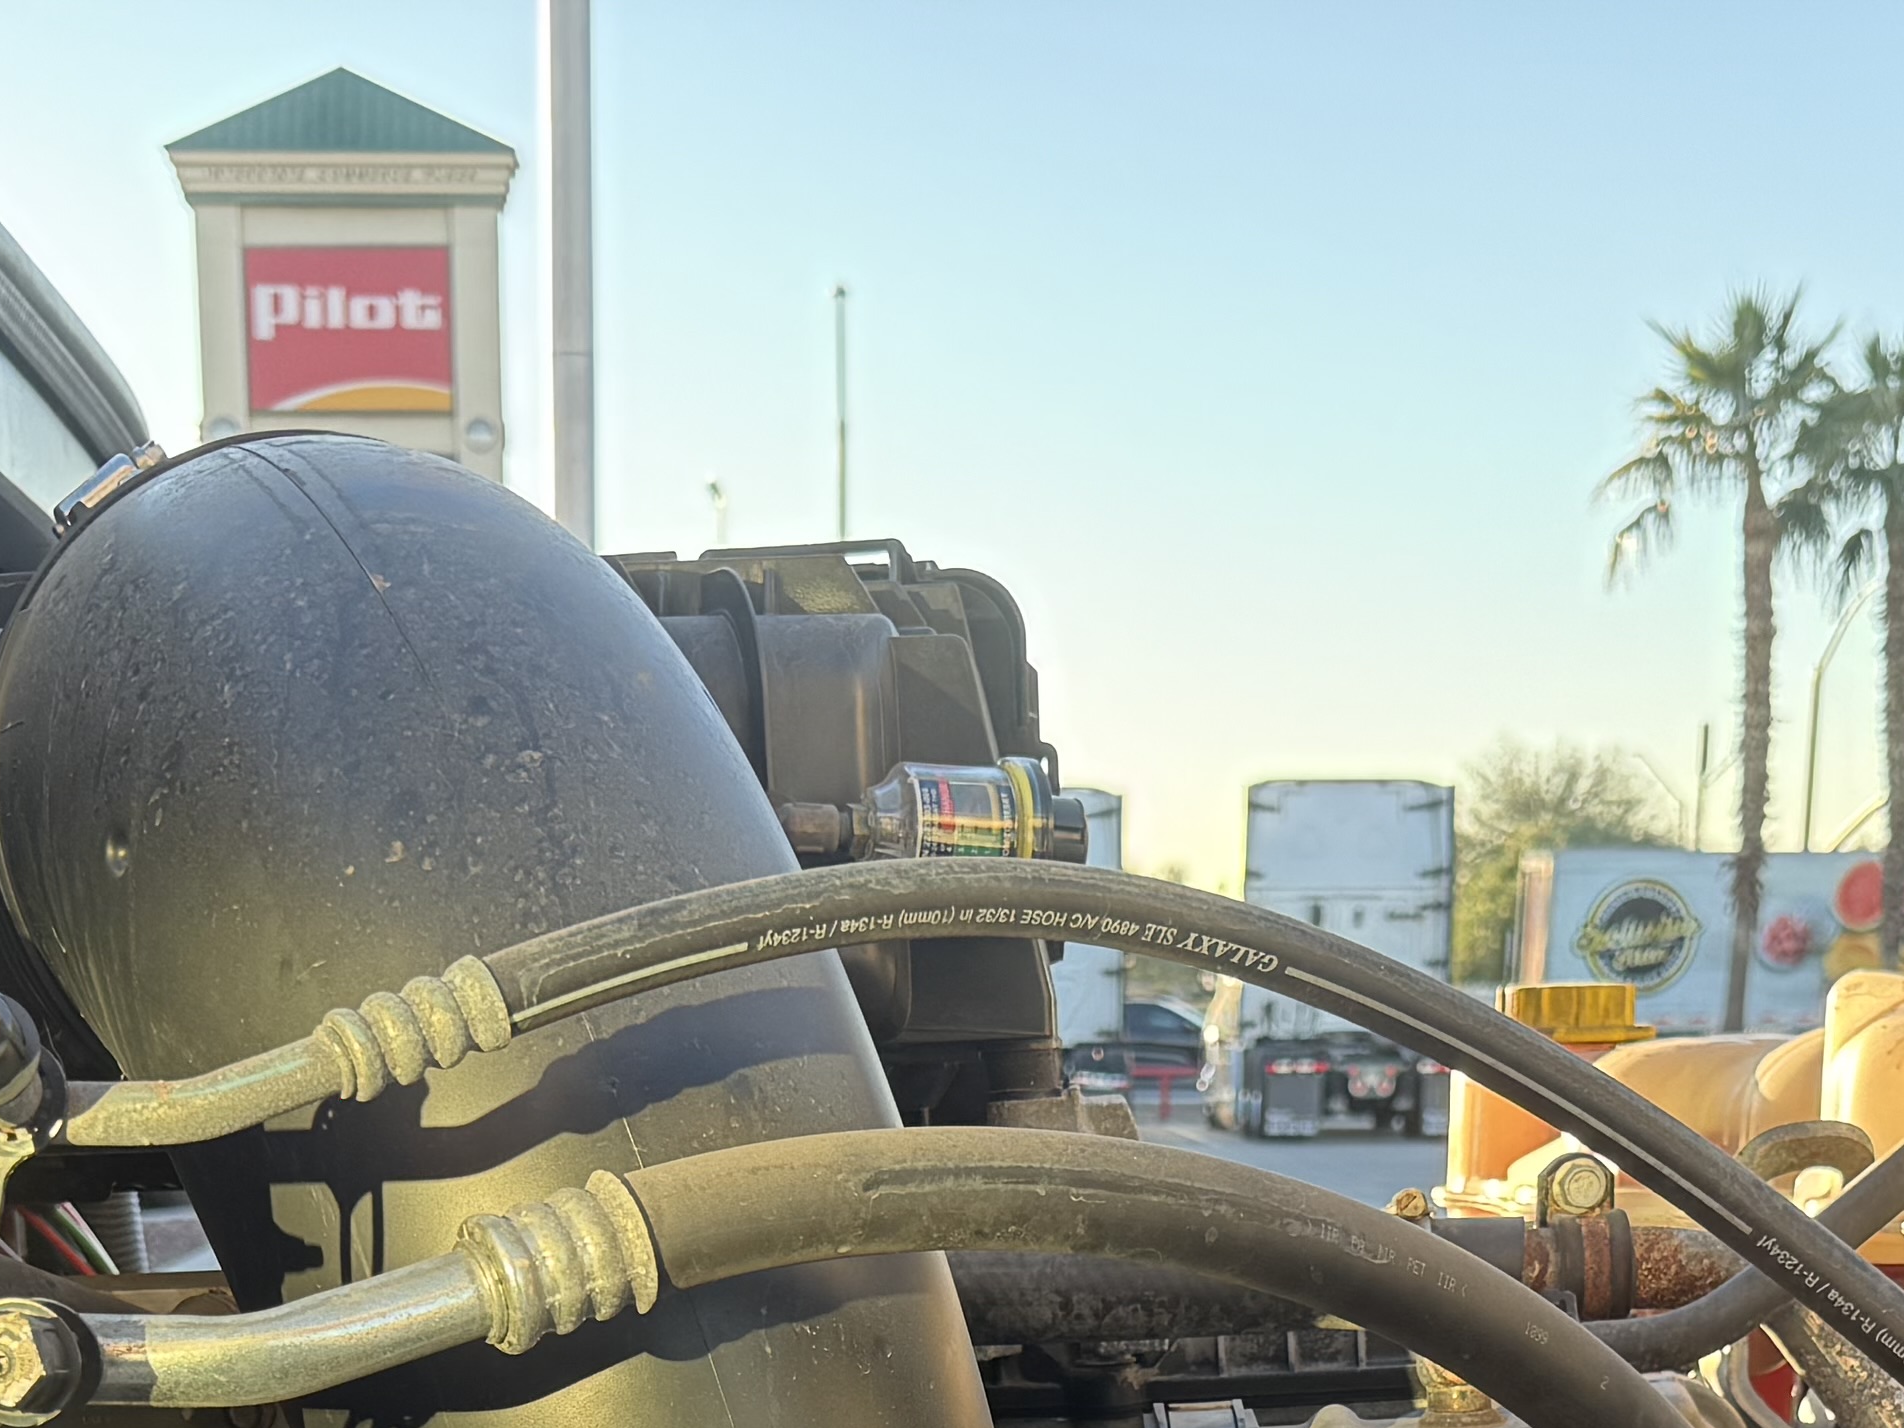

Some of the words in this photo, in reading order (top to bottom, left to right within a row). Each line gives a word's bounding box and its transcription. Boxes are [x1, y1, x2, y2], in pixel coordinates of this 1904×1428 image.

[251, 282, 443, 341] Pilot
[840, 913, 893, 933] R-134a
[898, 906, 956, 928] (10mm)
[959, 908, 973, 922] in
[975, 907, 1016, 924] 13/32
[1020, 909, 1067, 927] HOSE
[1069, 912, 1100, 930] A/C
[756, 924, 826, 951] R-1234yf
[1101, 918, 1140, 936] 4890
[1141, 923, 1178, 946] SLE
[1177, 932, 1279, 973] GALAXY
[1827, 1289, 1877, 1334] R-134a
